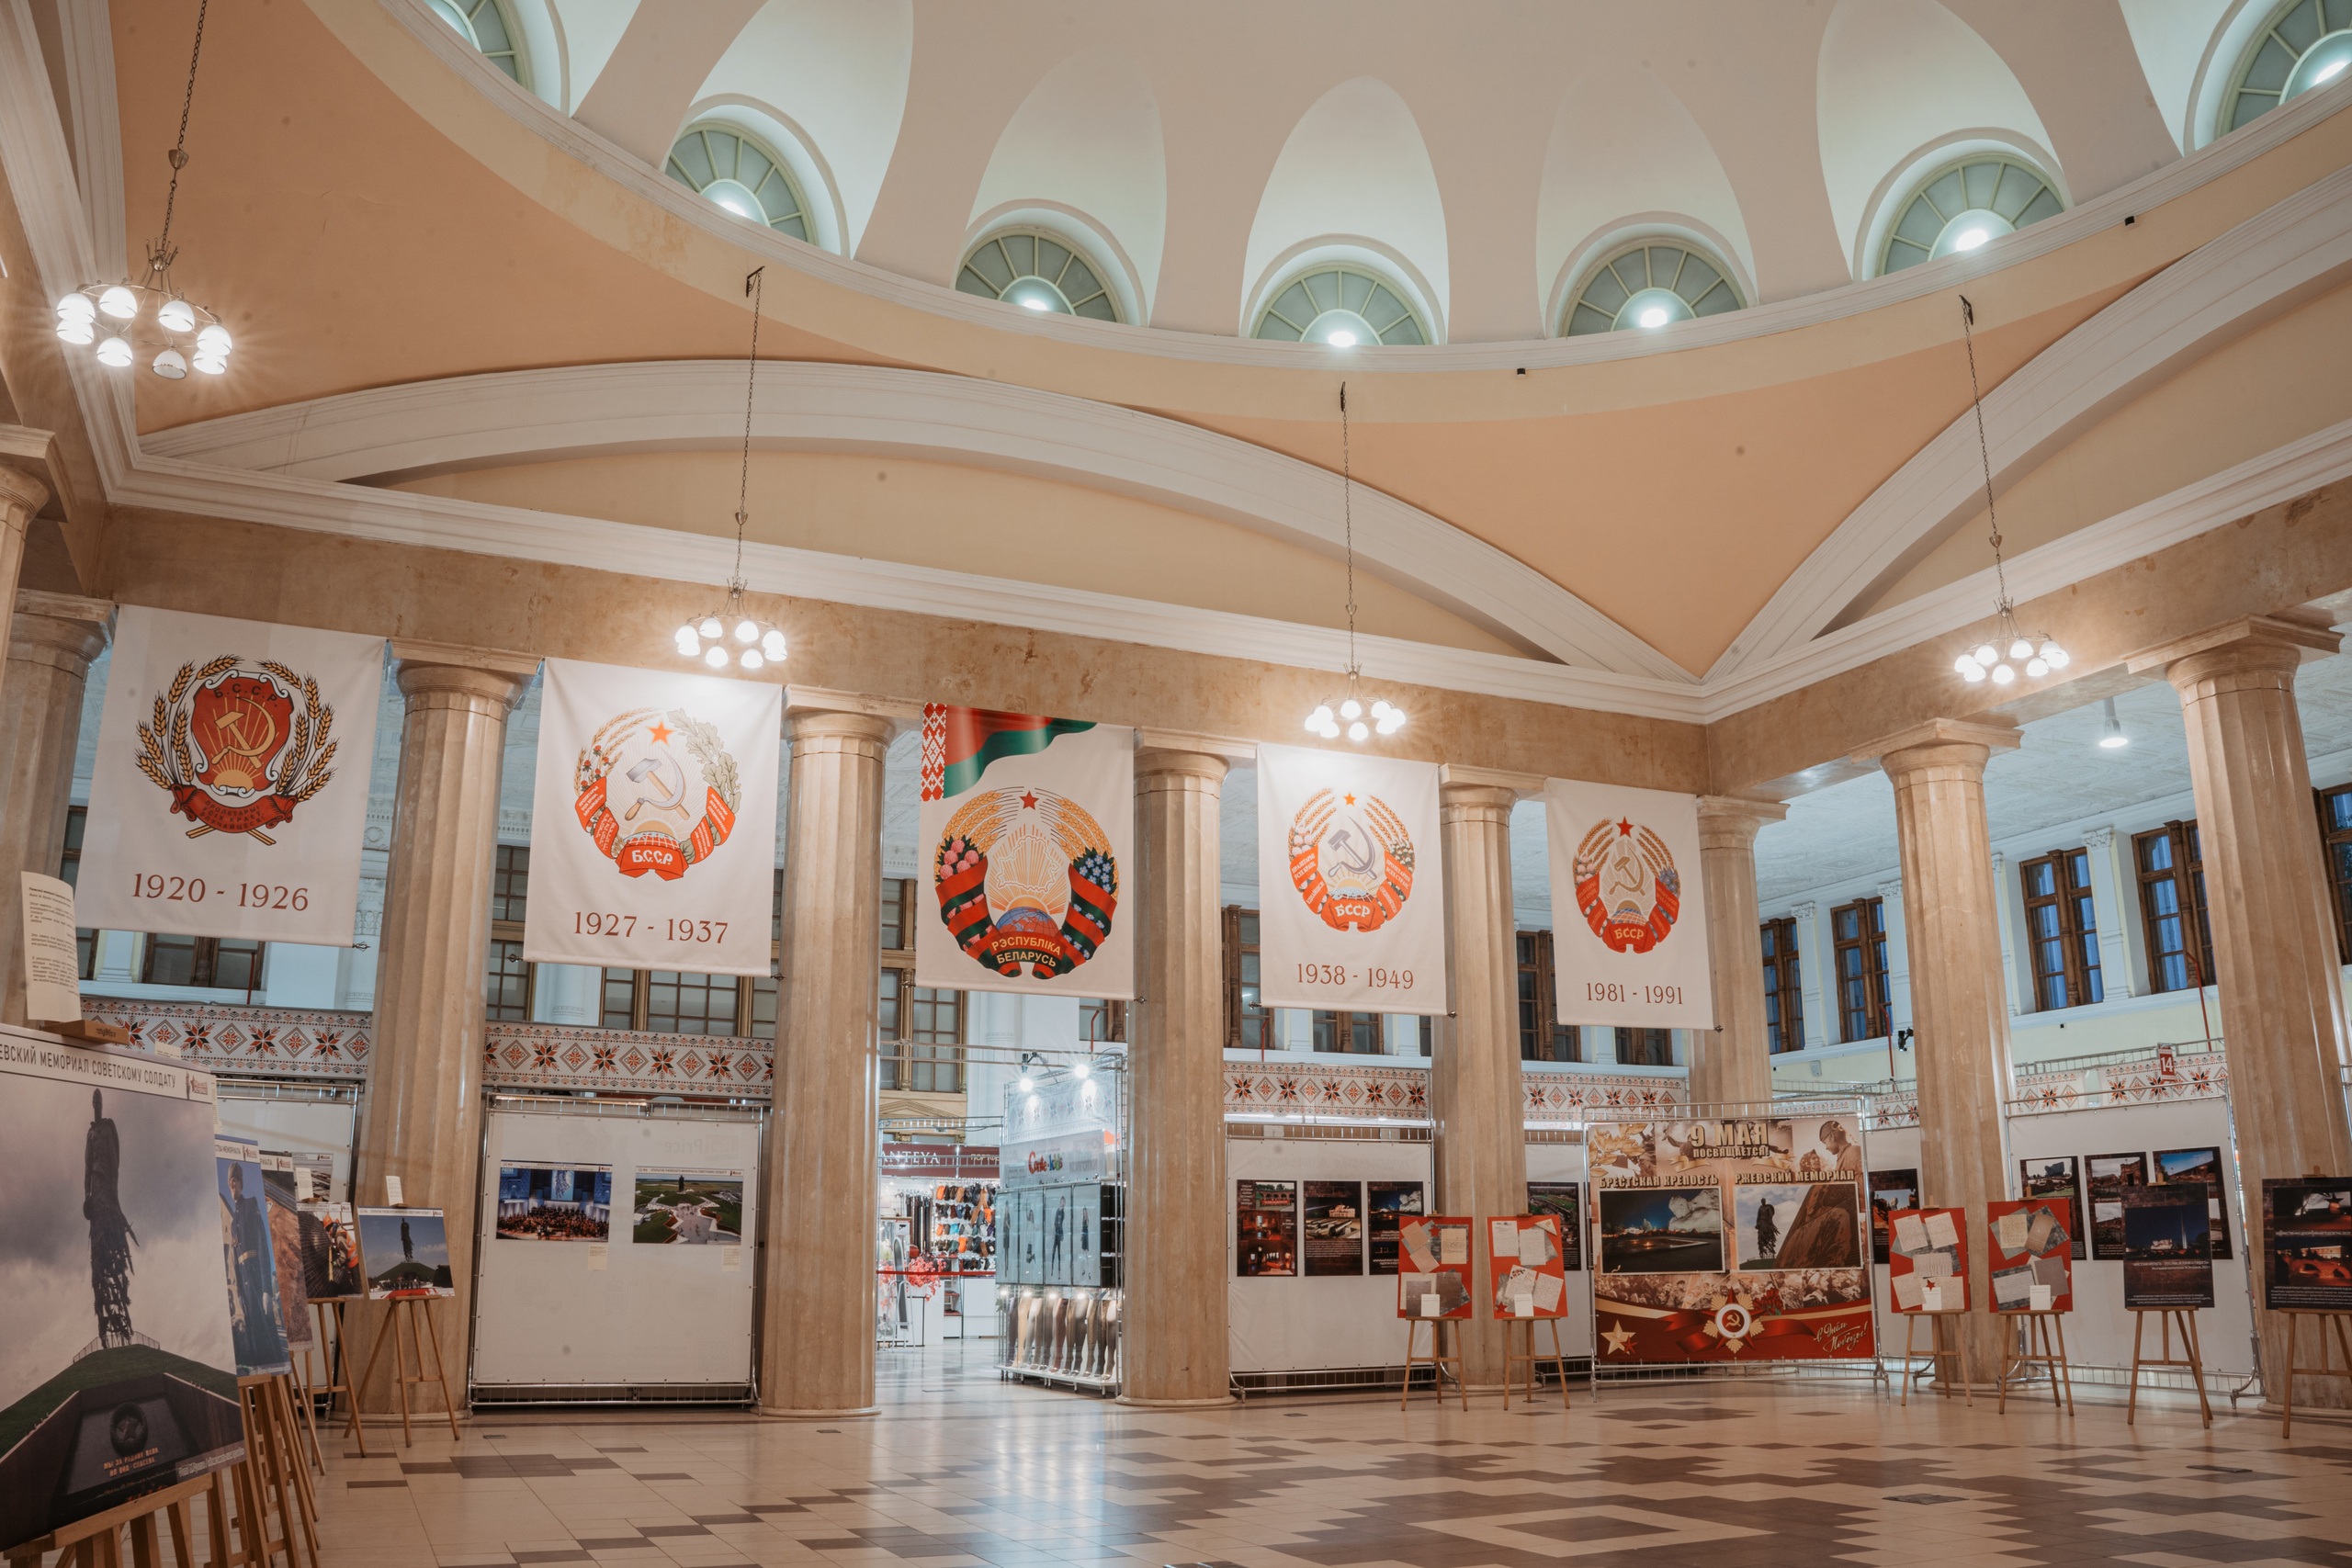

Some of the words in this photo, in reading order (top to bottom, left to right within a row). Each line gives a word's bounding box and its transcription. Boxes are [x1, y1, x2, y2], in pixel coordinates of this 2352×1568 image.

[131, 873, 206, 903] 1920
[238, 883, 309, 911] 1926
[1334, 902, 1371, 918] БССР
[574, 911, 638, 938] 1927
[667, 918, 729, 944] 1937
[1613, 927, 1645, 941] БССР
[990, 936, 1061, 956] РЭСПУБЛІКА
[995, 951, 1057, 968] БЕЛАРУСЬ
[1297, 963, 1346, 986] 1938
[1367, 967, 1414, 990] 1949
[1587, 982, 1625, 1003] 1981
[1645, 985, 1683, 1005] 1991
[40, 1051, 89, 1074] МЕМОРИАЛ
[92, 1059, 141, 1082] СОВЕТСКОМУ
[144, 1071, 175, 1089] СОЛДАТУ
[2160, 1056, 2173, 1072] 14
[1690, 1124, 1705, 1147] 9
[1714, 1122, 1769, 1147] МАЯ
[1693, 1145, 1770, 1159] ПОСВЯЩАЕТСЯ!
[1599, 1175, 1661, 1189] БРЕСТСКАЯ
[1663, 1174, 1719, 1187] КРЕПОСТЬ
[1735, 1169, 1792, 1184] РЖЕВСКИЙ
[1795, 1169, 1855, 1182] МЕМОРИАЛ
